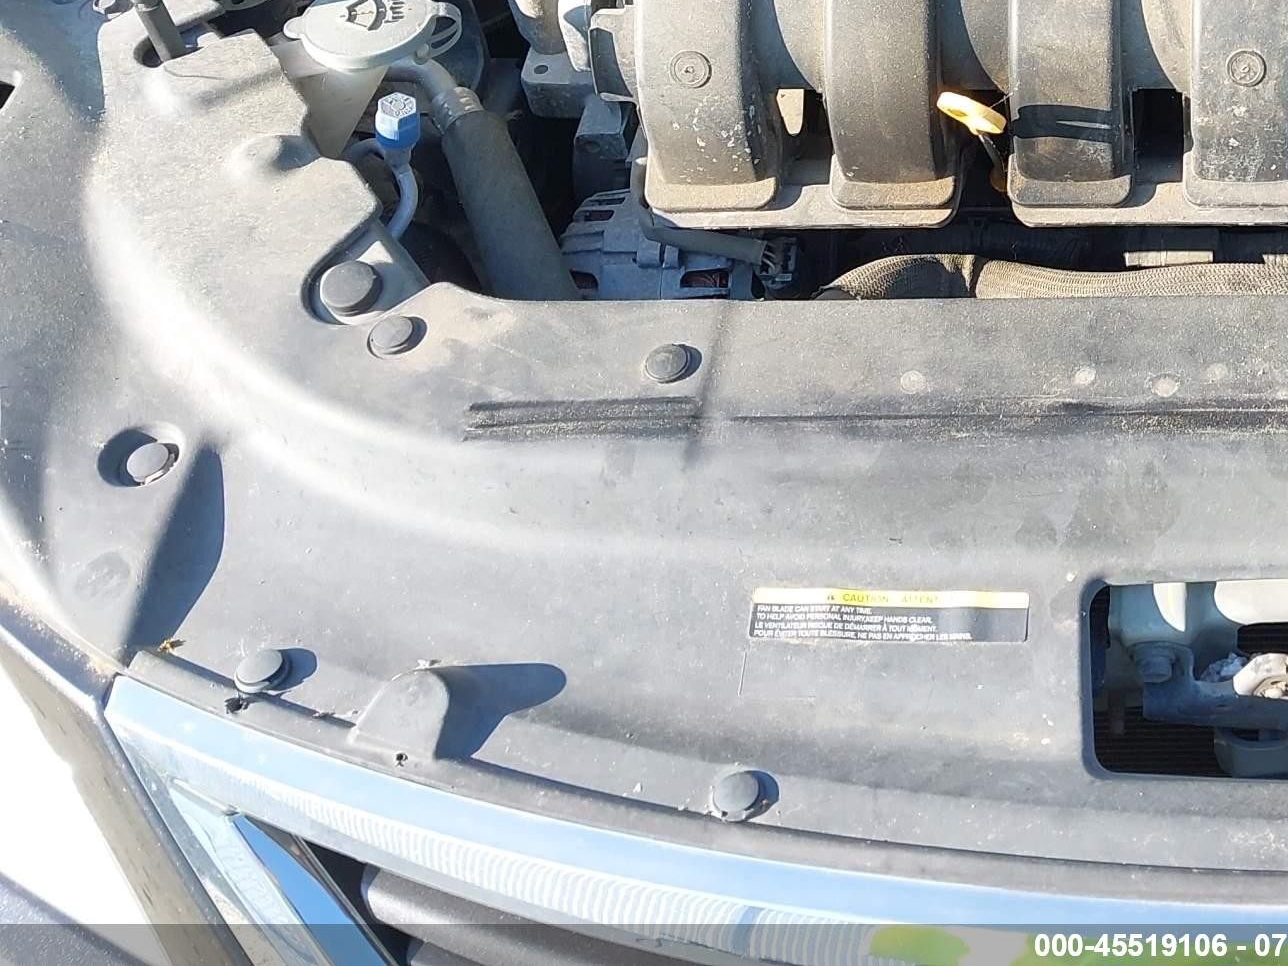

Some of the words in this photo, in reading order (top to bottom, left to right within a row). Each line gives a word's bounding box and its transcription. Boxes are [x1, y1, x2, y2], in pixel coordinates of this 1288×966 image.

[842, 593, 889, 603] CAUTION
[755, 621, 763, 629] LE
[834, 622, 843, 630] DE
[754, 629, 774, 637] POUR
[868, 632, 882, 640] PAS
